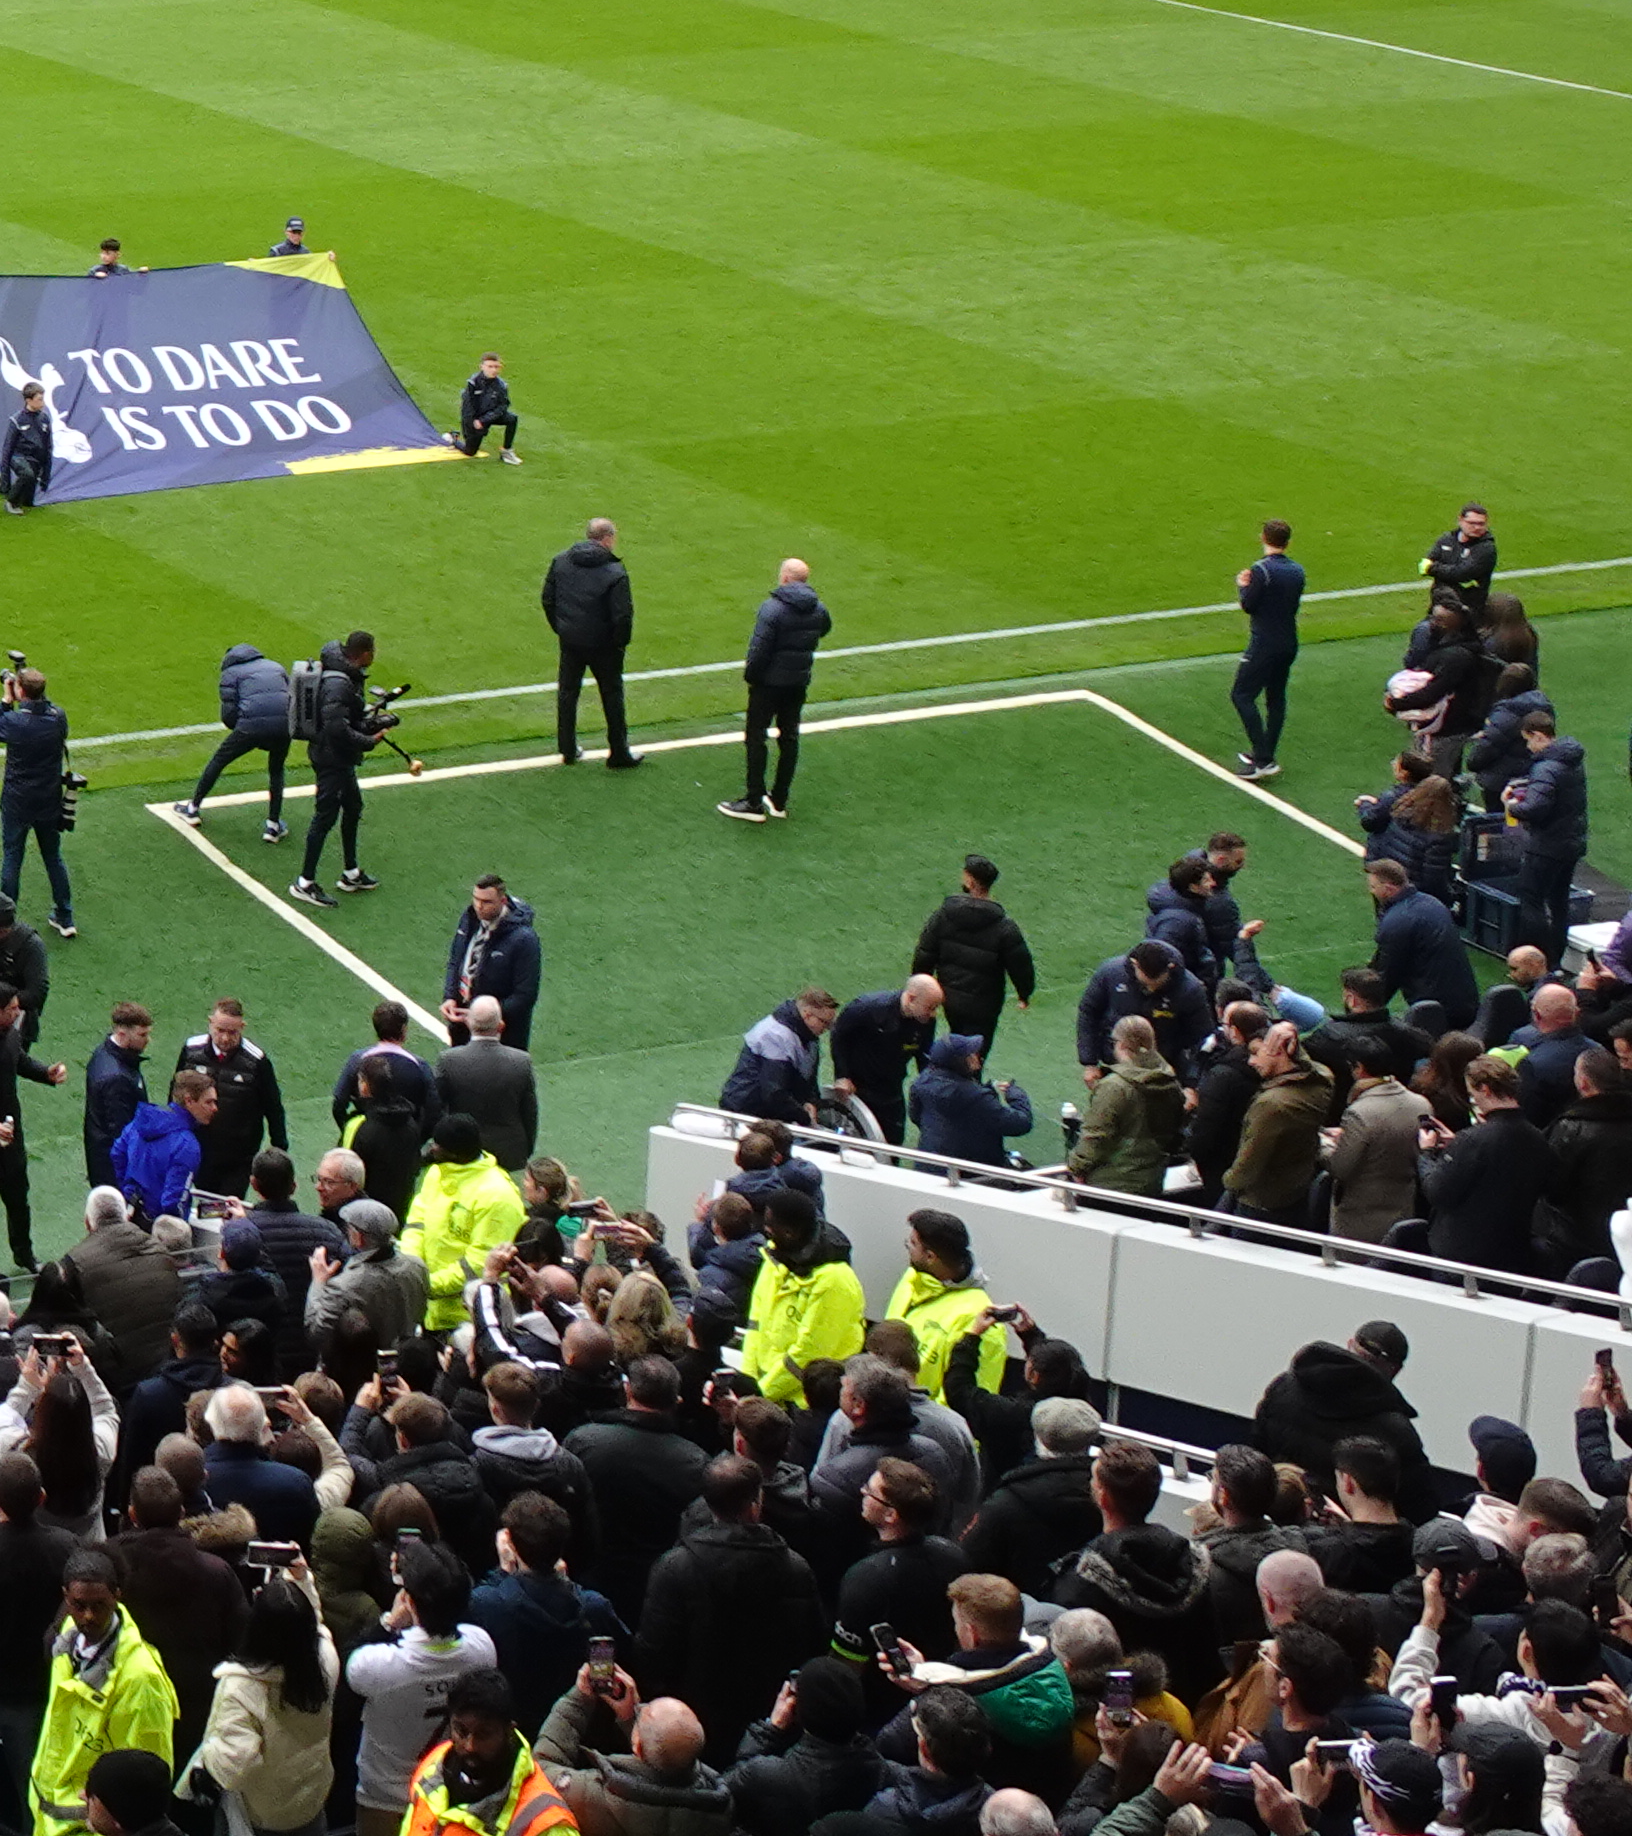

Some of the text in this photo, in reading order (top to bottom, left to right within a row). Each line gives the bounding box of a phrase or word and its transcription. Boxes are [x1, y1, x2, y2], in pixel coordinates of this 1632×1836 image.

[68, 338, 322, 395] TO DARE
[101, 395, 352, 451] IS TO DO
[425, 1681, 449, 1697] SO
